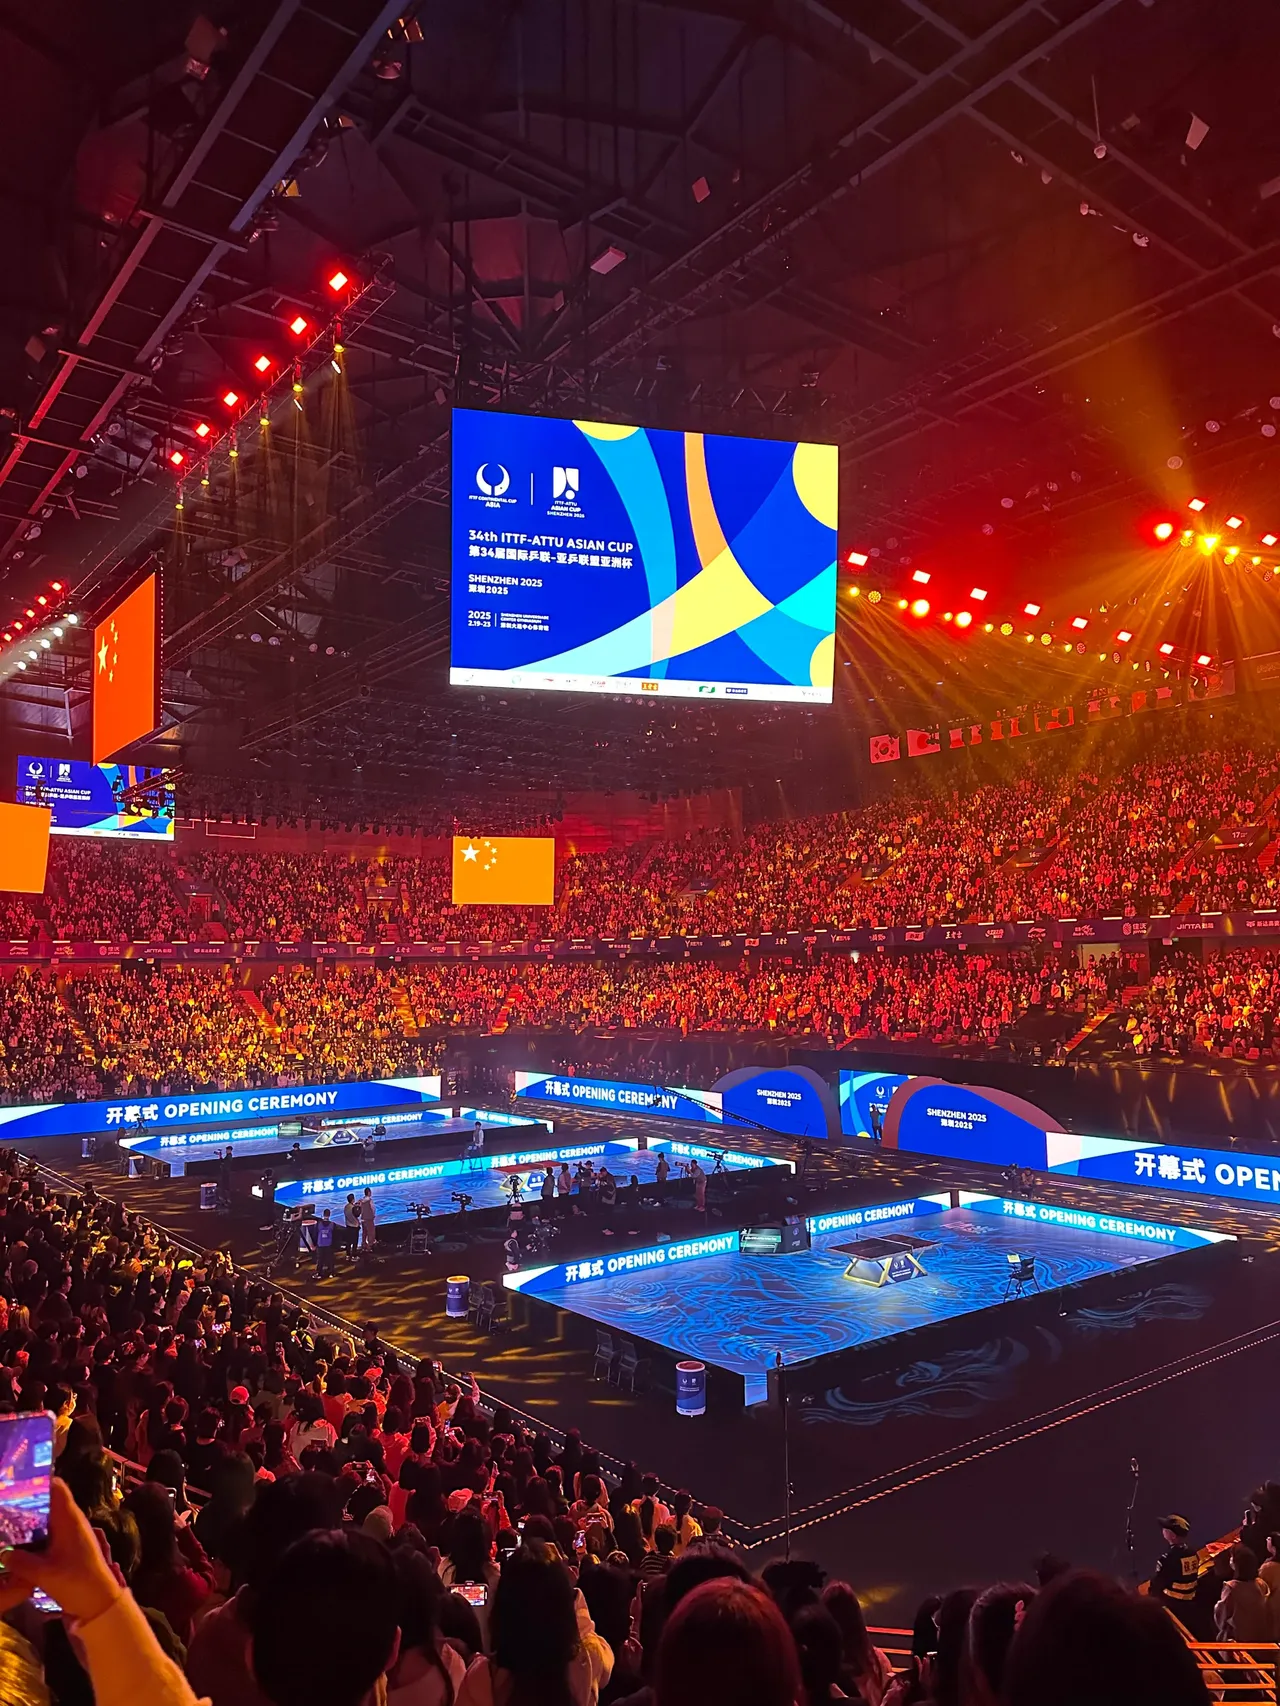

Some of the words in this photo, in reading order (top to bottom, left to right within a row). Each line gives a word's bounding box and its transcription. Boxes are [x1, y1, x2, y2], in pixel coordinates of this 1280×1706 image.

[469, 530, 498, 542] 34th
[501, 532, 564, 547] ITTF-ATTU
[567, 539, 605, 551] ASIAN
[608, 541, 633, 553] CUP
[468, 574, 518, 586] SHENZHEN
[520, 577, 543, 588] 2025
[468, 584, 509, 595] 深圳2025
[468, 610, 492, 620] 2025
[545, 1080, 571, 1097] 开幕式
[572, 1084, 616, 1102] OPENING
[756, 1088, 787, 1099] SHENZHEN
[787, 1092, 802, 1101] 2025
[106, 1104, 159, 1125] 开幕式
[164, 1099, 243, 1119] OPENING
[248, 1091, 338, 1113] CEREMONY
[926, 1107, 967, 1120] SHENZHEN
[967, 1112, 987, 1122] 2025
[381, 1113, 423, 1124] CEREMONY
[189, 1131, 231, 1144] OPENING
[519, 1151, 558, 1164] OPENING
[560, 1145, 606, 1158] CEREMONY
[723, 1153, 765, 1168] CEREMONY
[1134, 1152, 1207, 1184] 开幕式
[302, 1178, 334, 1194] 开幕式
[337, 1173, 386, 1188] OPENING
[388, 1165, 444, 1181] CEREMONY
[818, 1212, 862, 1231] OPENING
[864, 1202, 915, 1222] CEREMONY
[1003, 1201, 1037, 1219] 开幕式
[1039, 1207, 1096, 1228] OPENING
[1099, 1218, 1176, 1242] CEREMONY
[565, 1259, 604, 1282] 开幕式
[607, 1249, 665, 1272] OPENING
[668, 1236, 734, 1260] CEREMONY
